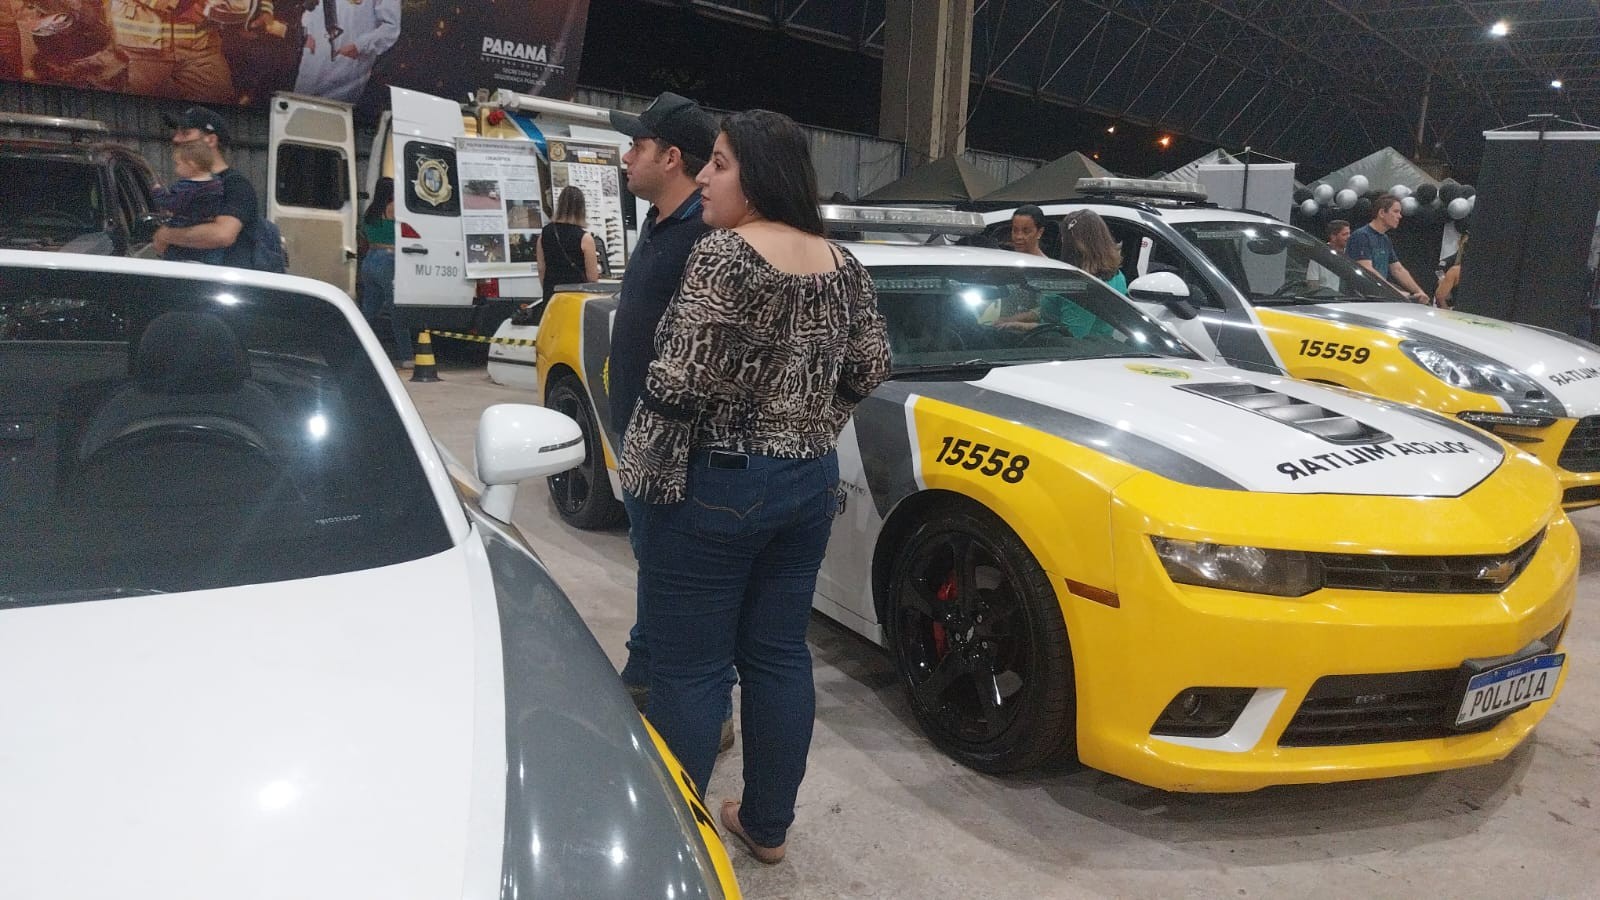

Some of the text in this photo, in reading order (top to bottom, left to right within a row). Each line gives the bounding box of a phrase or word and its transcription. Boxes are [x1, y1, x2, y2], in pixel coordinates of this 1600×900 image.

[482, 36, 547, 63] PARANÁ
[415, 264, 458, 277] MU 7380
[1299, 339, 1370, 364] 15559
[936, 436, 1030, 484] 15558
[1470, 671, 1547, 716] POLICIA
